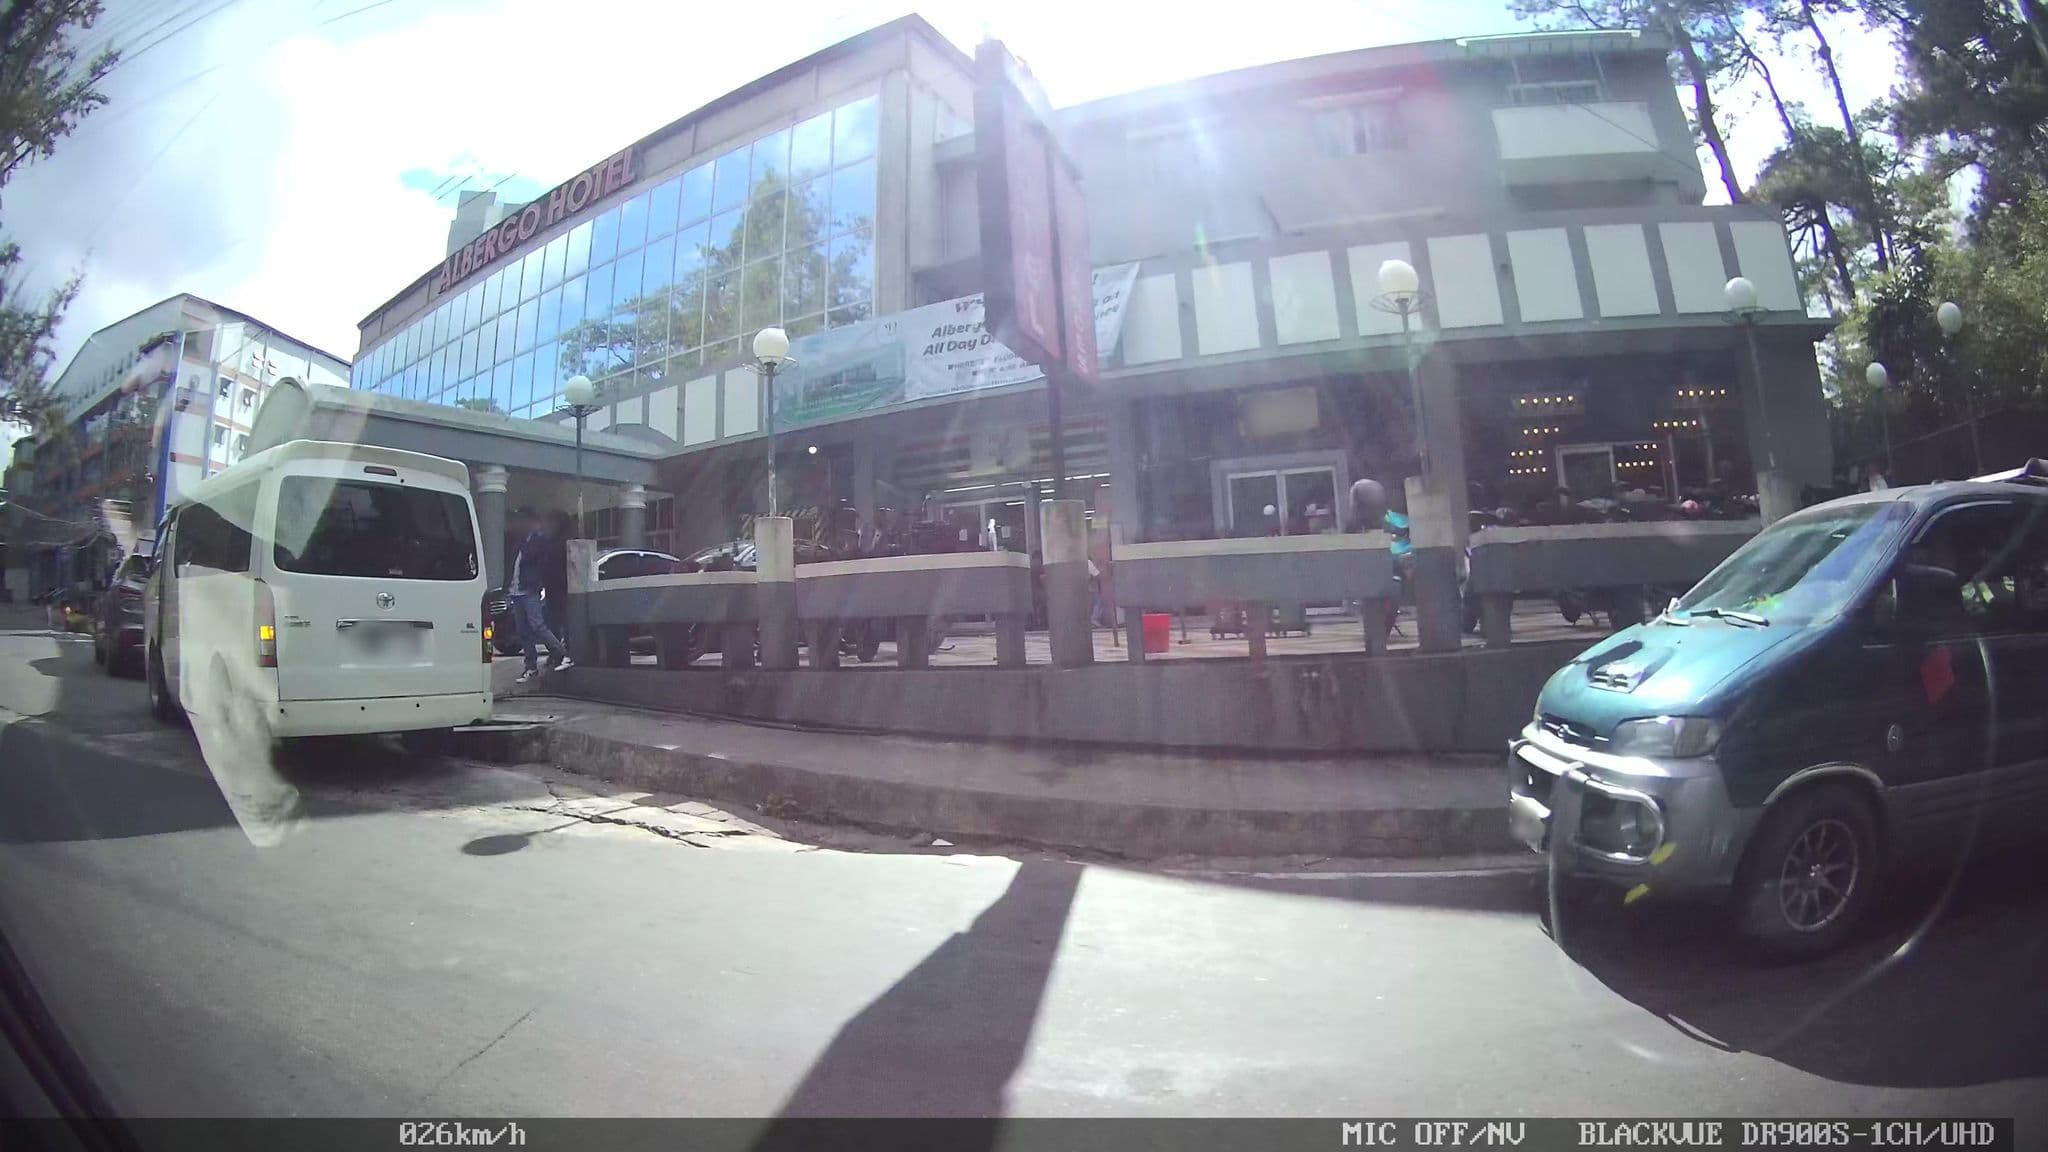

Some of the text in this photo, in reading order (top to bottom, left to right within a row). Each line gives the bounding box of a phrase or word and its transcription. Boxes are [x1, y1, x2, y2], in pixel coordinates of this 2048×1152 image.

[438, 149, 636, 294] ALBERGO HOTEL
[922, 342, 945, 357] All
[947, 338, 978, 352] Day
